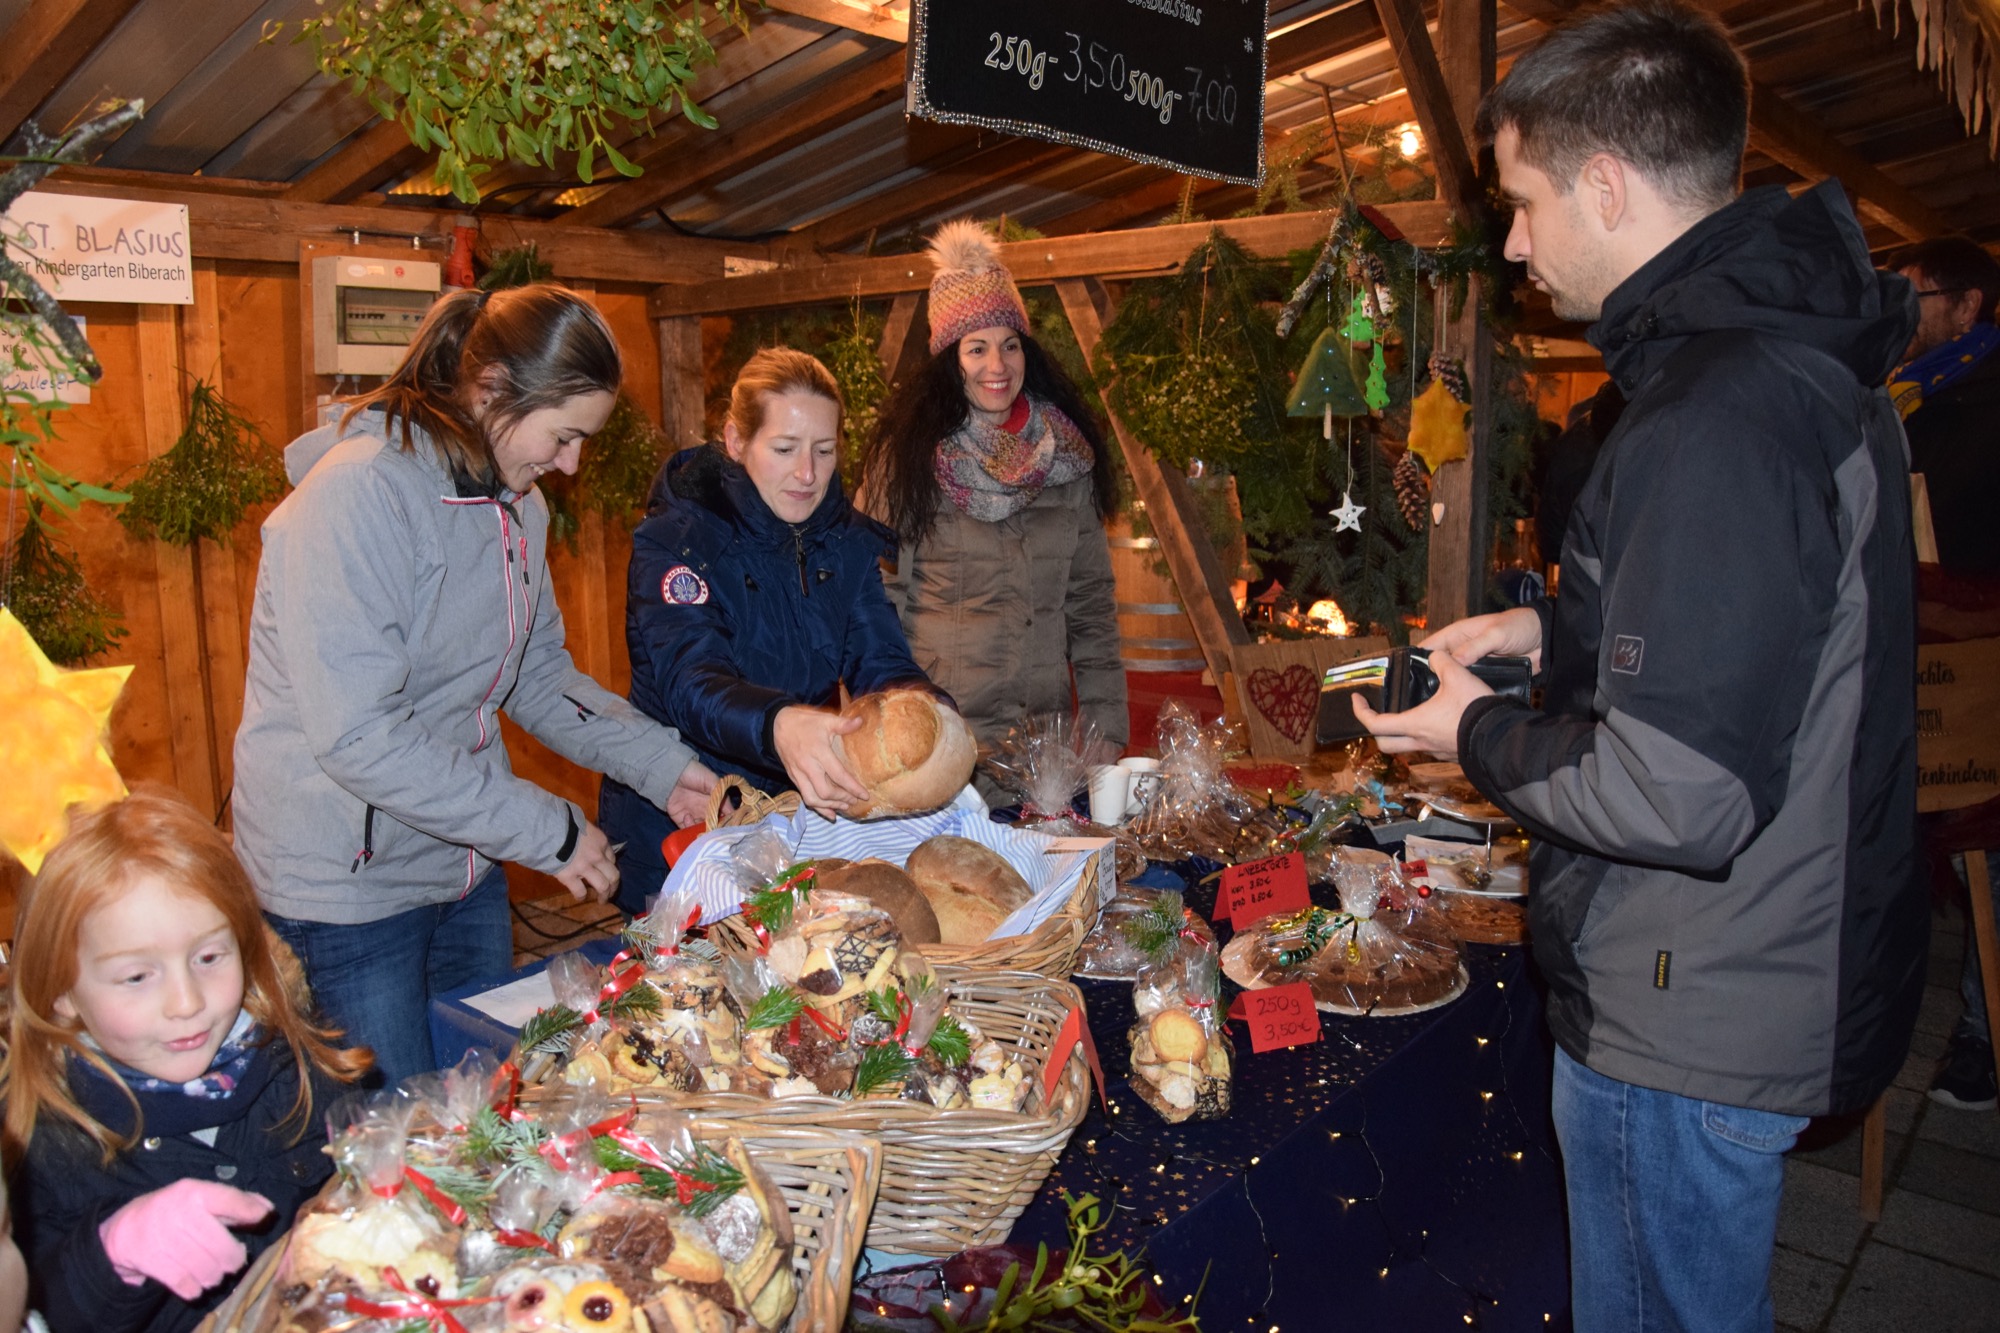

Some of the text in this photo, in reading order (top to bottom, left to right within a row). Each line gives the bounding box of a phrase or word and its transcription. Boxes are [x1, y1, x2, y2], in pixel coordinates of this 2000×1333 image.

[1063, 31, 1125, 94] 3,50
[24, 221, 184, 257] ST. BLASIUS
[35, 258, 125, 280] Kindergarten
[129, 262, 186, 281] Biberach
[1256, 995, 1301, 1016] 250g
